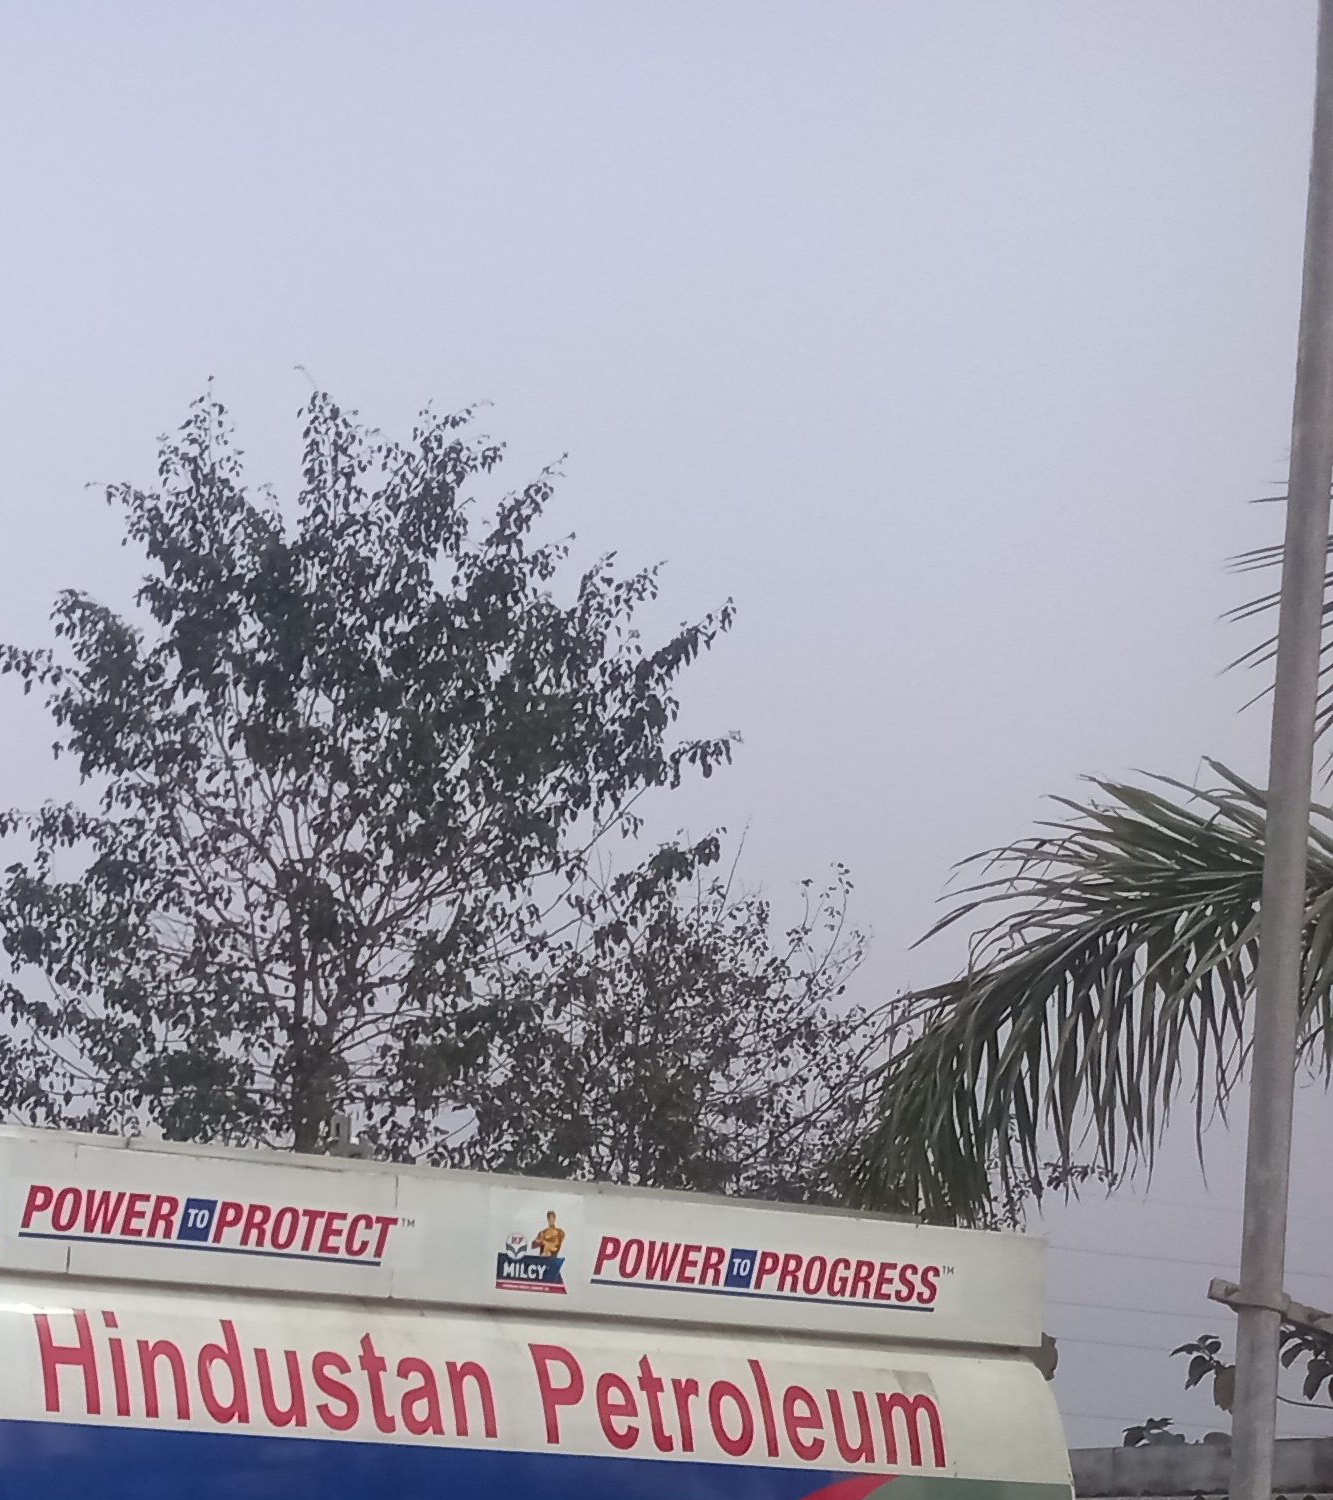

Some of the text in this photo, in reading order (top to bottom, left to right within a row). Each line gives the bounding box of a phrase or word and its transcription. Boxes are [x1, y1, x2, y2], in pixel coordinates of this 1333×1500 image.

[21, 1184, 179, 1239] POWER
[187, 1208, 209, 1229] TO
[212, 1201, 399, 1258] PROTECT
[502, 1260, 547, 1280] MILCY
[593, 1235, 726, 1287] POWER
[732, 1258, 750, 1277] TO
[753, 1250, 941, 1305] PROGRESS
[32, 1308, 947, 1469] Hindustan Petroleum
